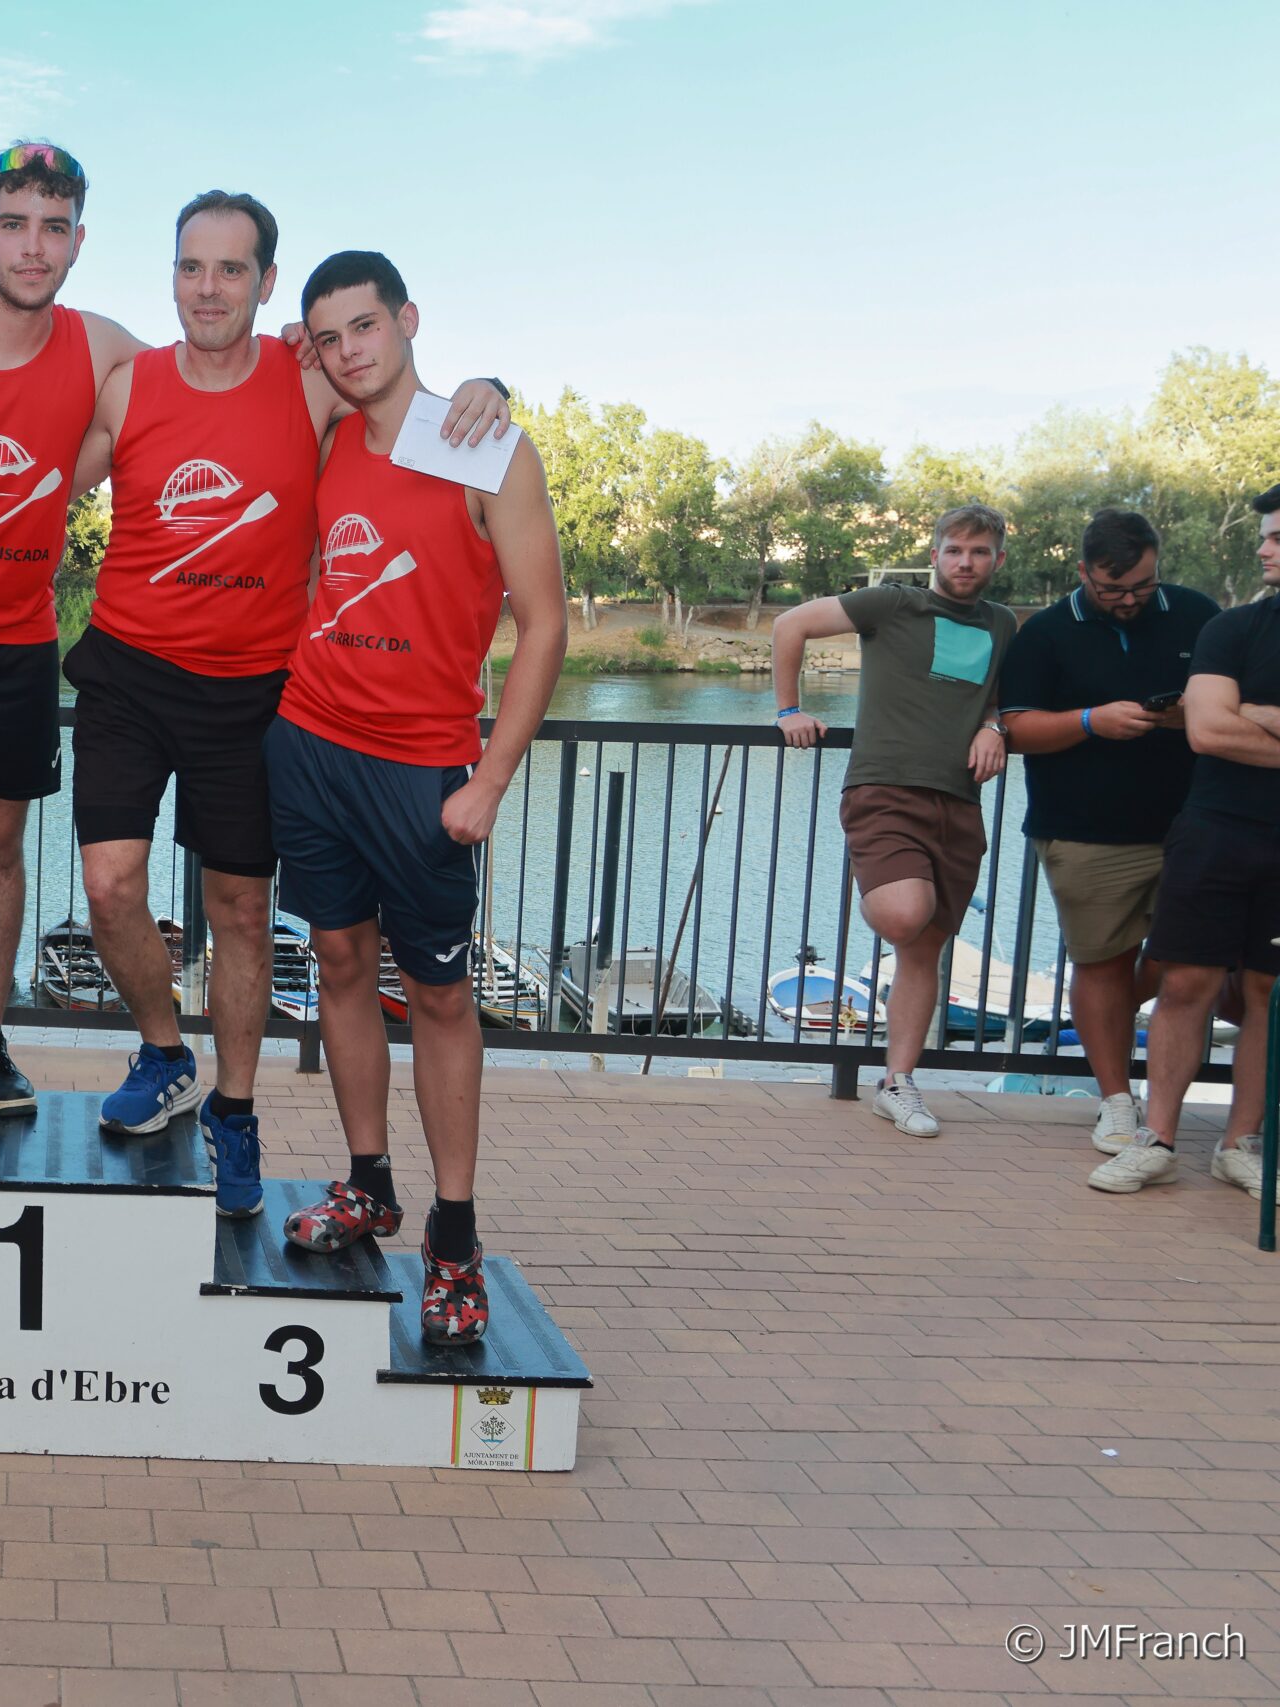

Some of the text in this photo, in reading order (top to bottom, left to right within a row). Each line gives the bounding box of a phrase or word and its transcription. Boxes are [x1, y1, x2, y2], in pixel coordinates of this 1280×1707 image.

[176, 571, 265, 589] ARRISCADA
[325, 630, 411, 652] ARRISCADA
[259, 1325, 324, 1415] 3
[31, 1369, 170, 1404] d'Ebre
